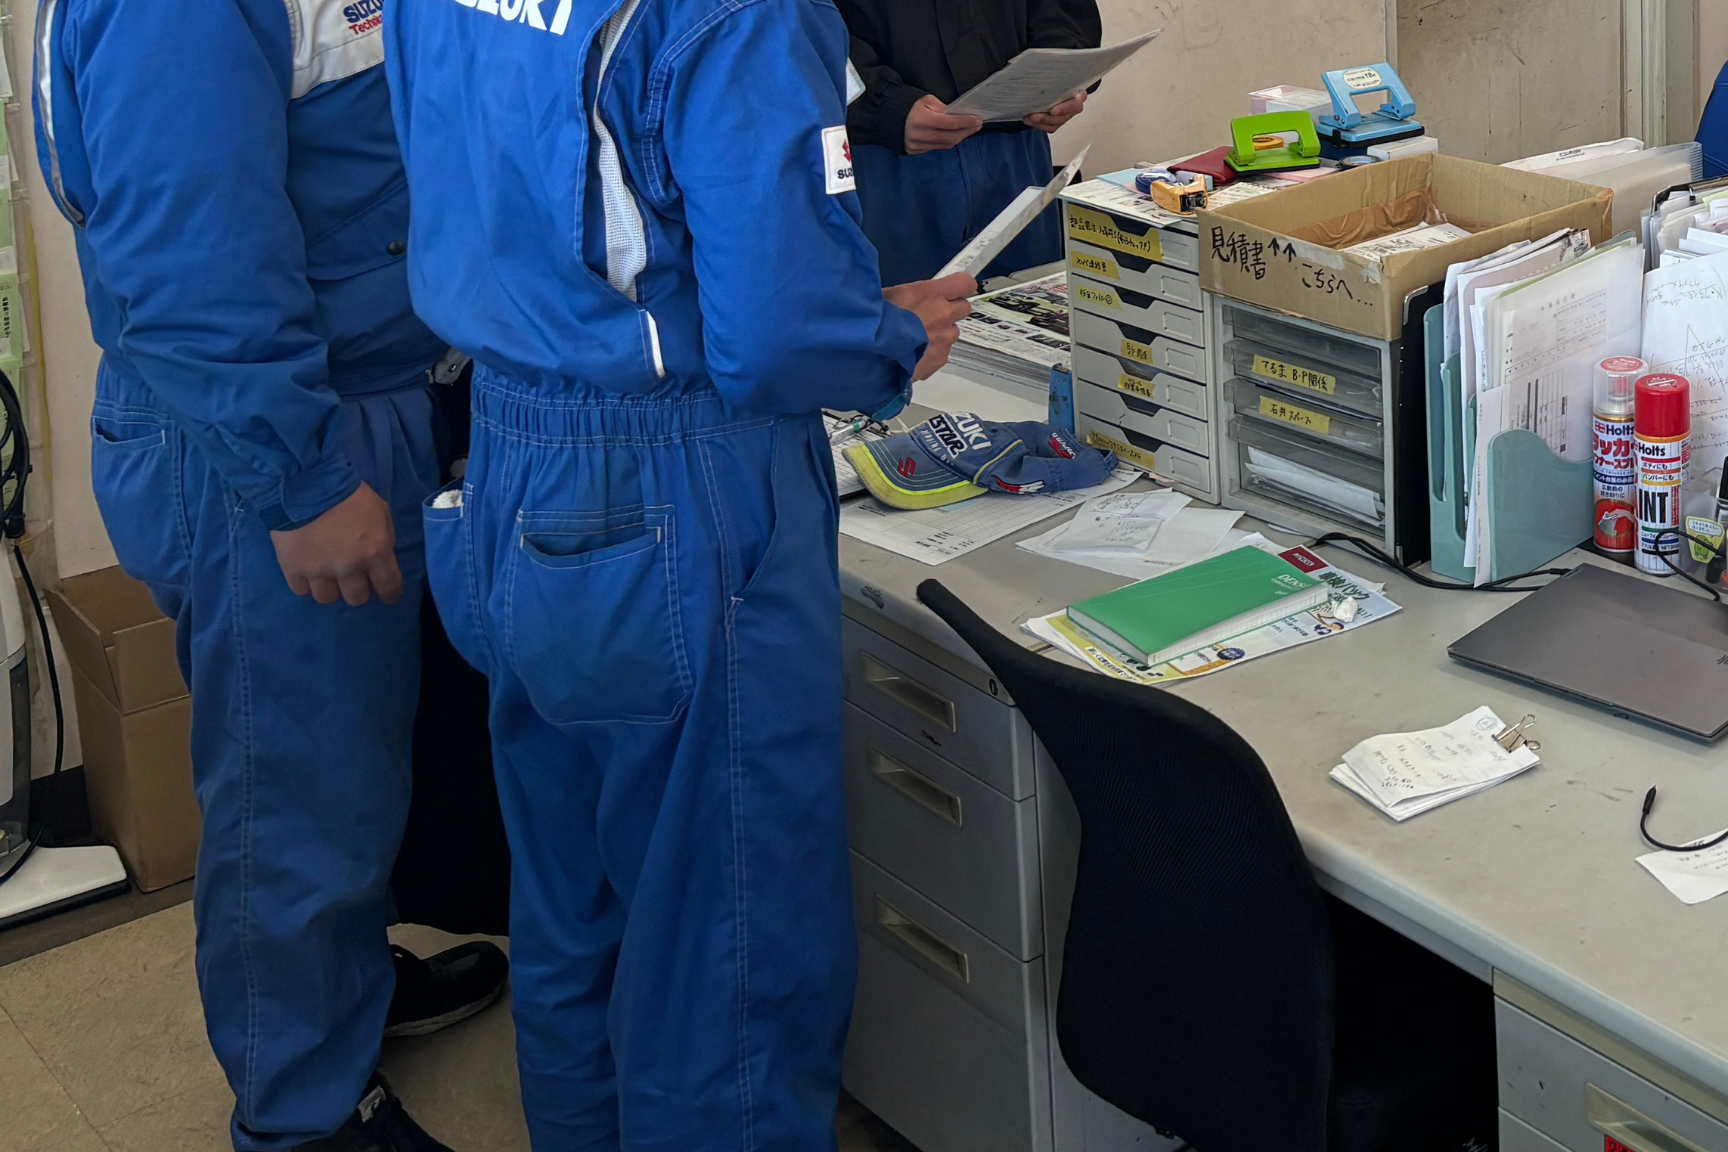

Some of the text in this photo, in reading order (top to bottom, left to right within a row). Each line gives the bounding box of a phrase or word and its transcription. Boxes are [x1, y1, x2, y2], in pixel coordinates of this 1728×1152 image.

[1211, 226, 1266, 280] 見積書
[1639, 442, 1666, 456] Holts
